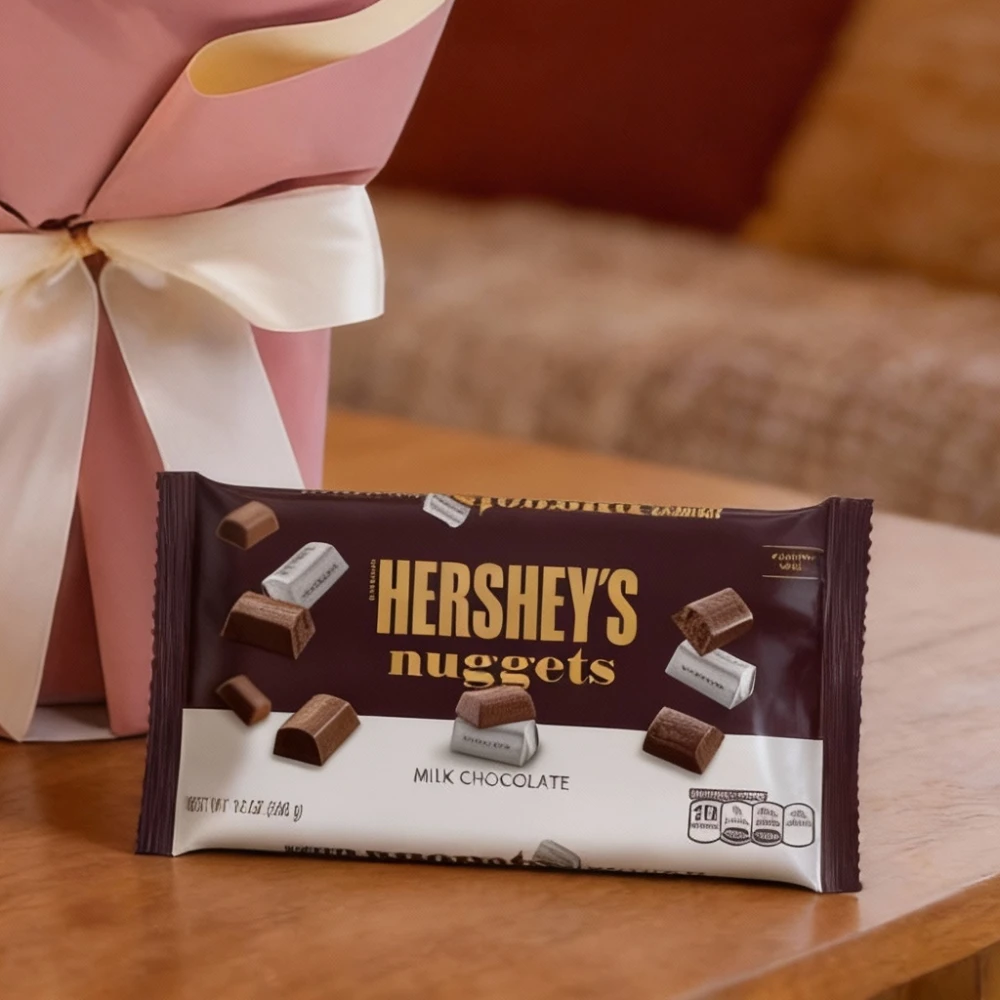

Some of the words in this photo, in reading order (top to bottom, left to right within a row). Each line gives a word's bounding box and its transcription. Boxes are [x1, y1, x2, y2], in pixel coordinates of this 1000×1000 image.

[376, 558, 639, 647] HERSHEY'S
[387, 648, 616, 691] nuggets
[413, 767, 455, 785] MILK
[459, 770, 571, 791] CHOCOLATE
